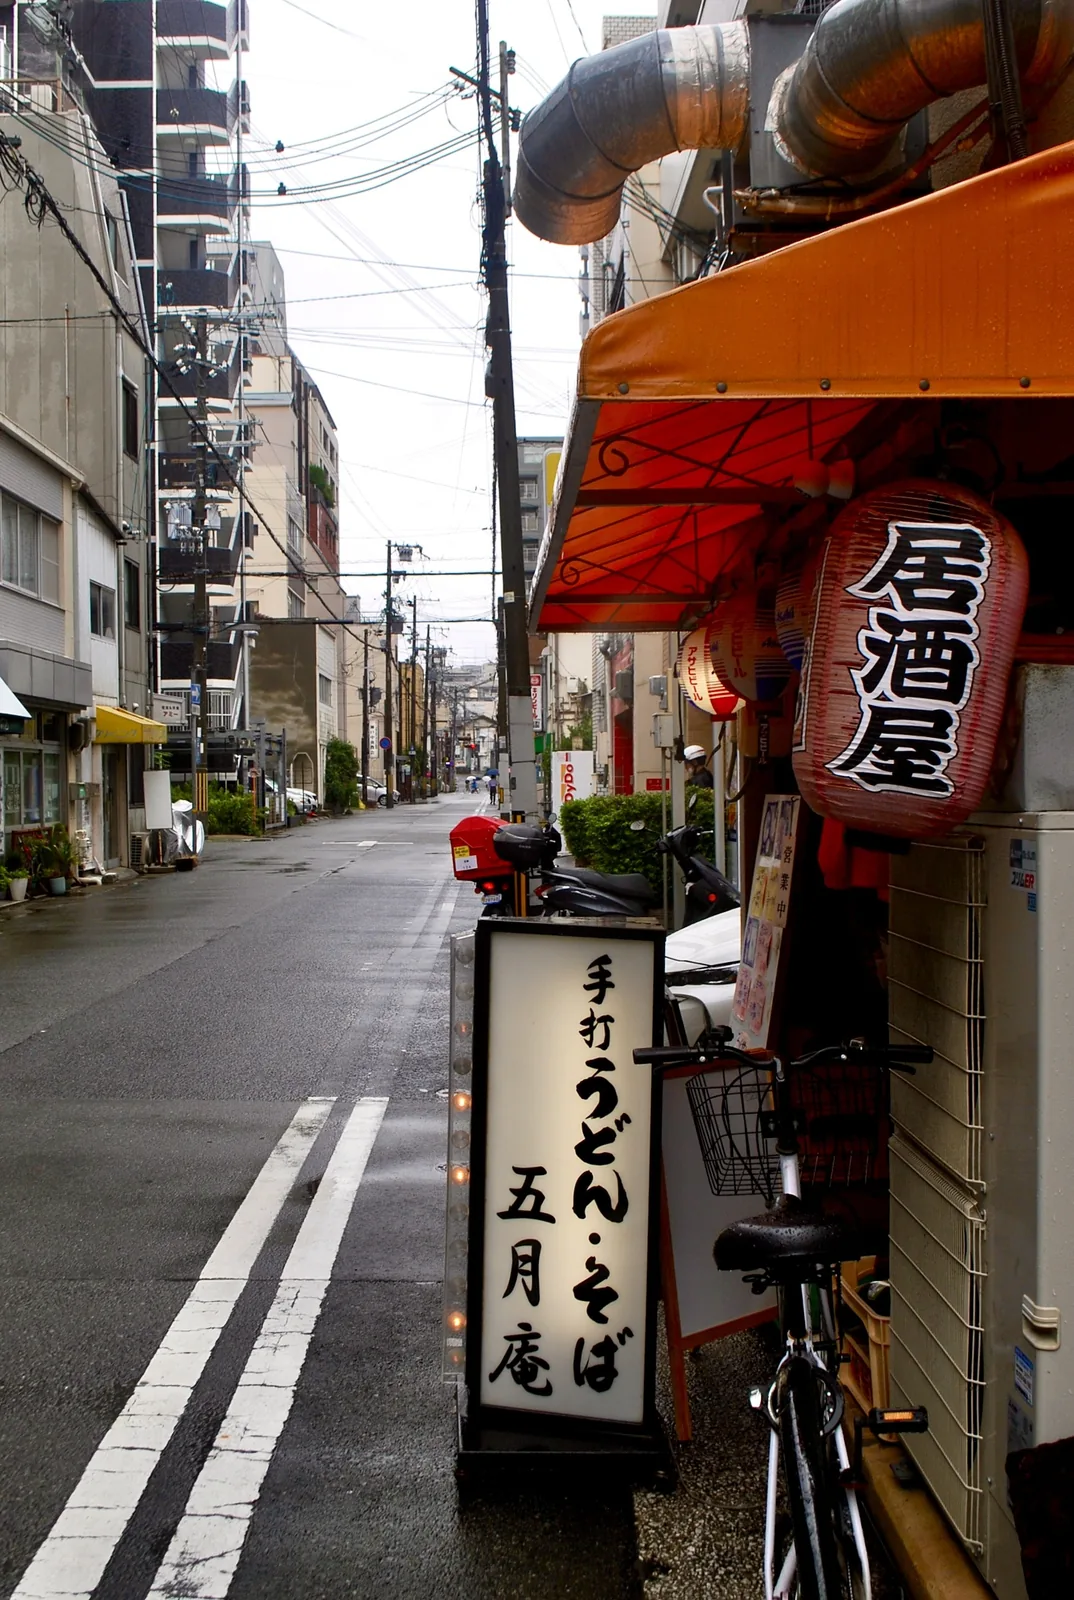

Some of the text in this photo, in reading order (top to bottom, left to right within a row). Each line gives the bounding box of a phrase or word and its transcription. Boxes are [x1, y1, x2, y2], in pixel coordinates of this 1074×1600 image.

[687, 646, 703, 701] アサヒビール
[824, 519, 993, 800] 居酒屋
[564, 763, 577, 804] DyDo
[776, 845, 793, 919] 営業中
[488, 1165, 556, 1397] 五月庵
